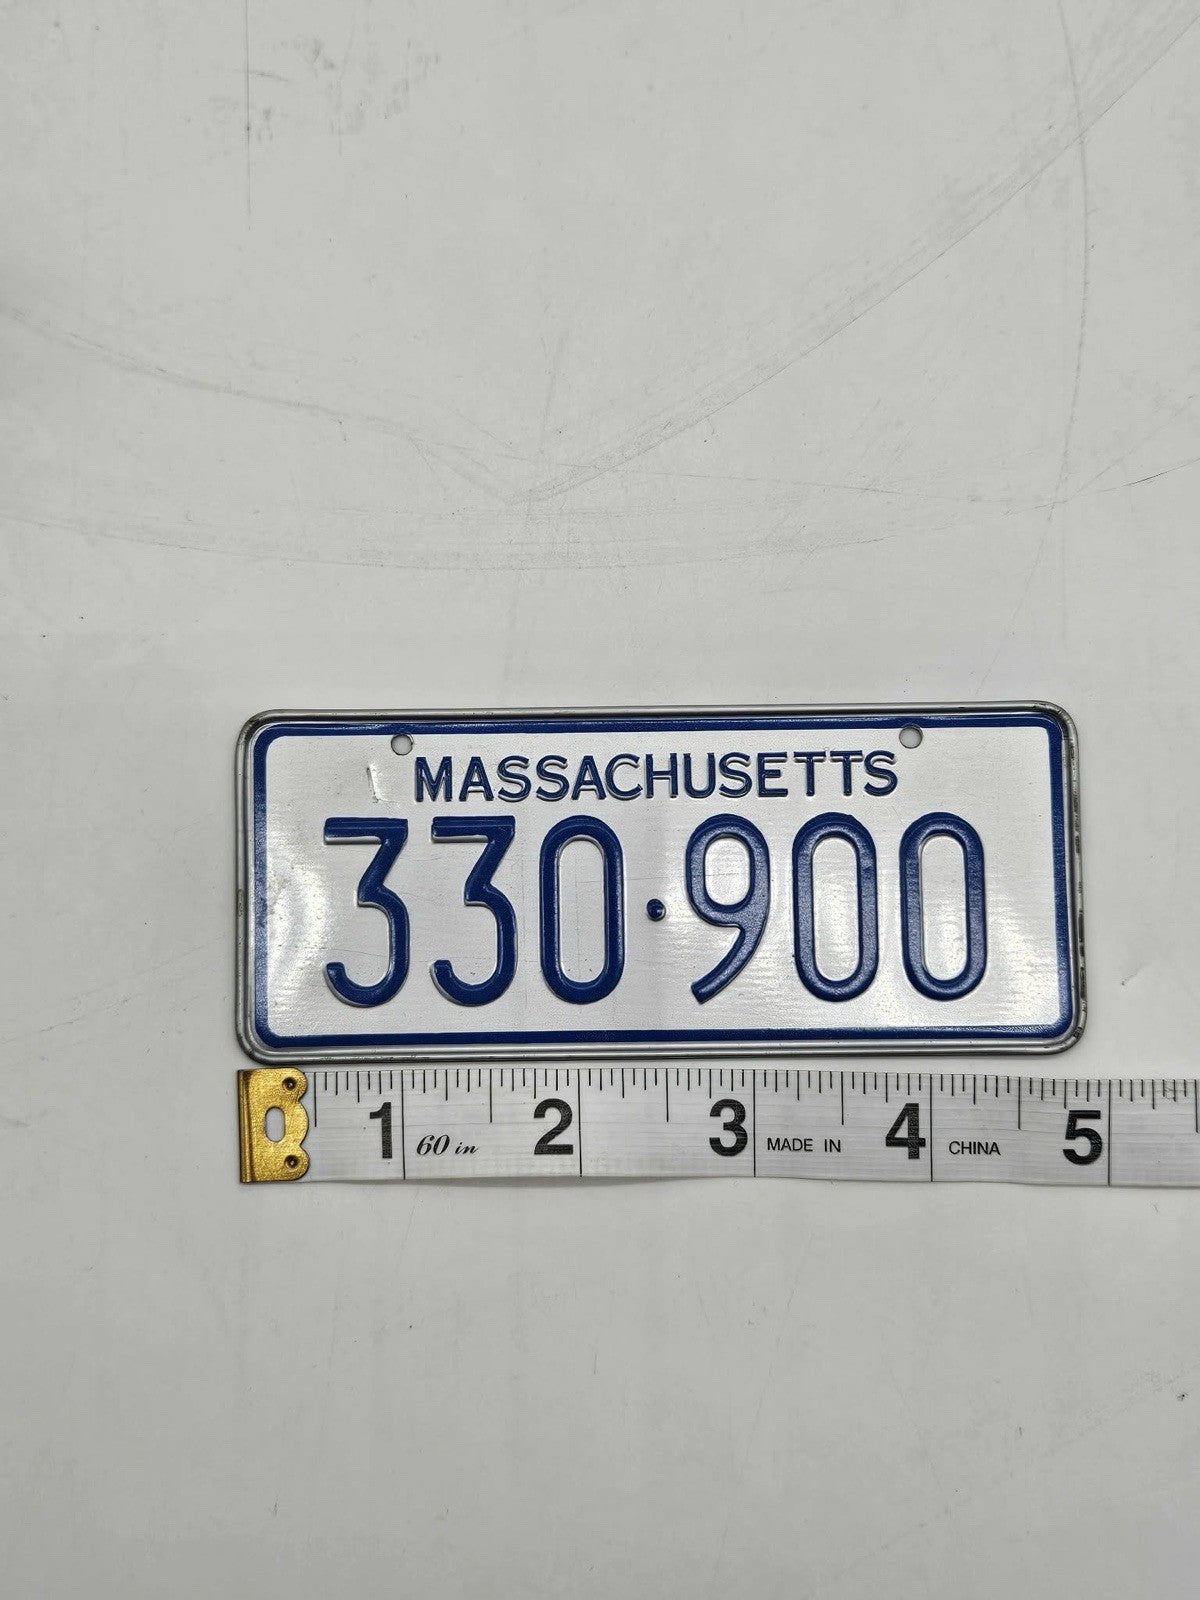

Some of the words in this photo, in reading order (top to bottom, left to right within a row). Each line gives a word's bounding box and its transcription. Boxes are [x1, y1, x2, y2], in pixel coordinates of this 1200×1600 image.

[415, 750, 899, 803] MASSACHUSETTS
[369, 1101, 393, 1160] 1
[416, 1134, 448, 1157] 60
[455, 1137, 479, 1155] in
[533, 1099, 574, 1156] 2
[709, 1098, 749, 1157] 3
[767, 1136, 814, 1153] MADE
[824, 1138, 842, 1153] IN
[885, 1102, 926, 1160] 4
[948, 1140, 1002, 1156] CHINA
[1063, 1109, 1103, 1166] 5
